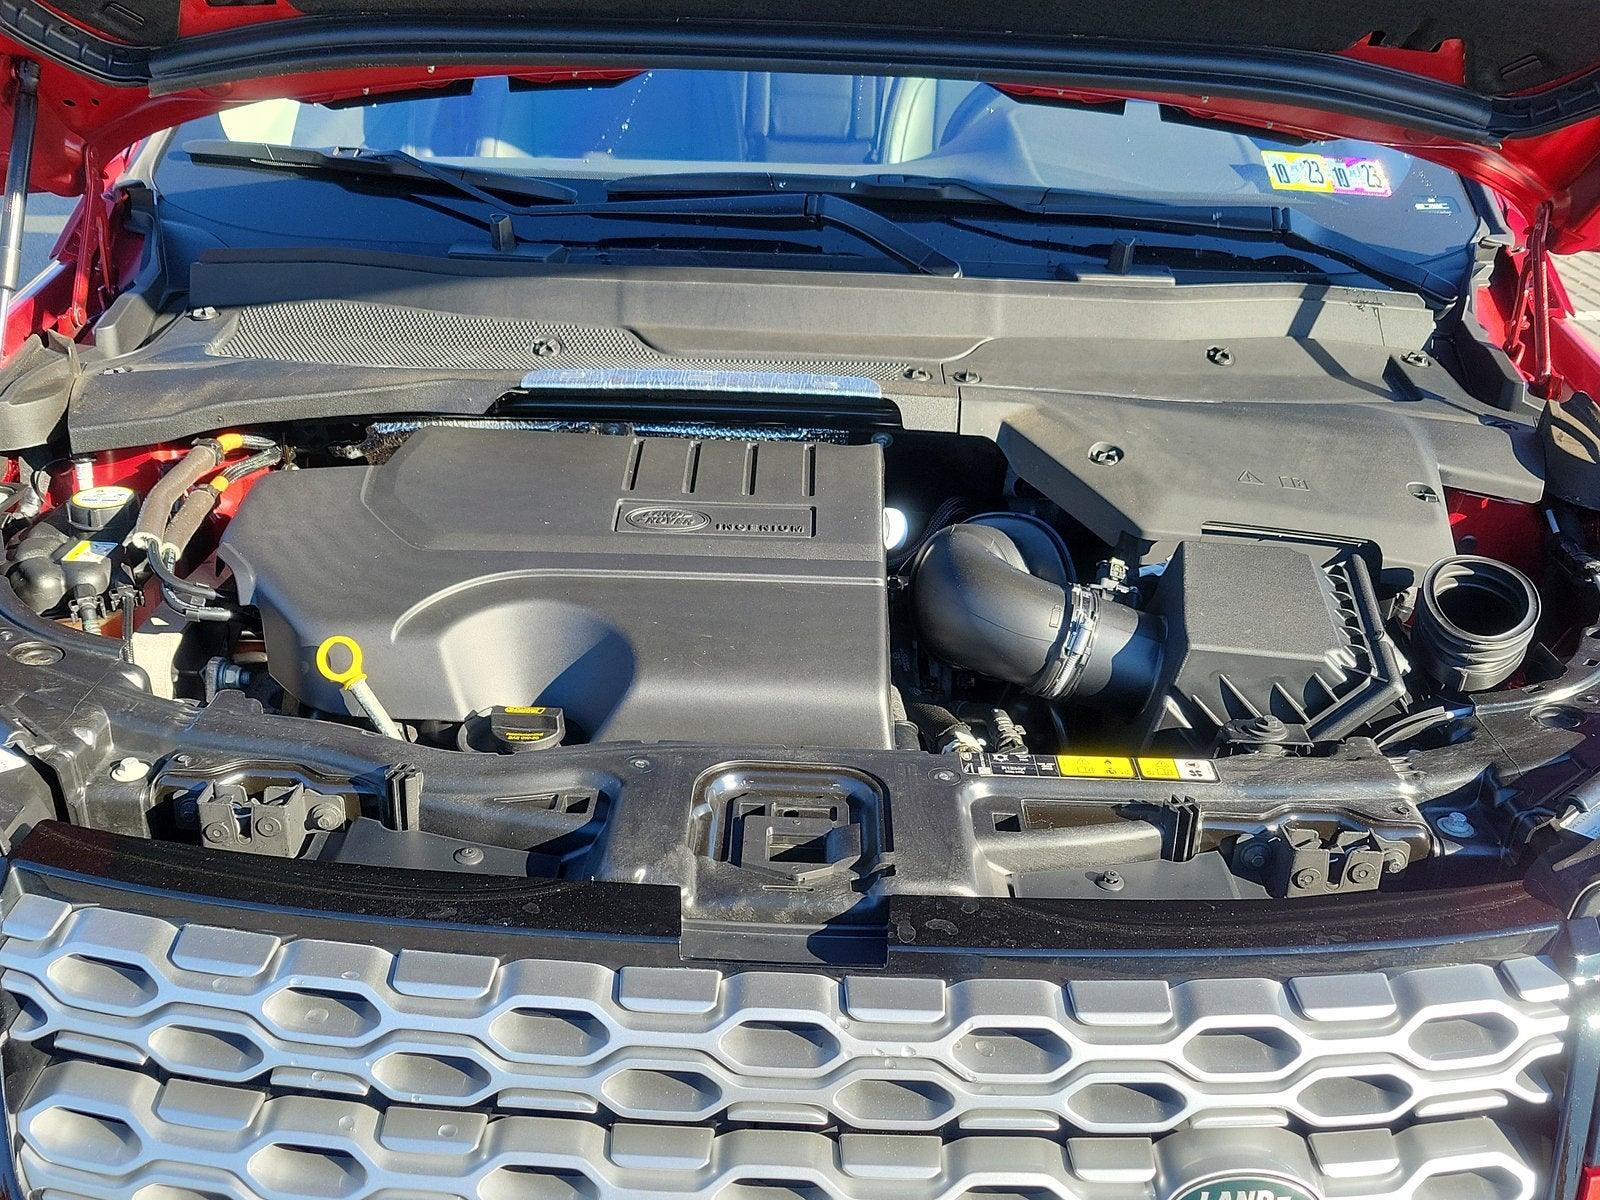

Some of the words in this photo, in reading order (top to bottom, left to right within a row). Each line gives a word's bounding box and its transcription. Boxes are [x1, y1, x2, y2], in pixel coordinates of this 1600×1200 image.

[1303, 159, 1325, 184] 23
[1361, 164, 1383, 188] 23
[715, 523, 805, 533] INGENIUM
